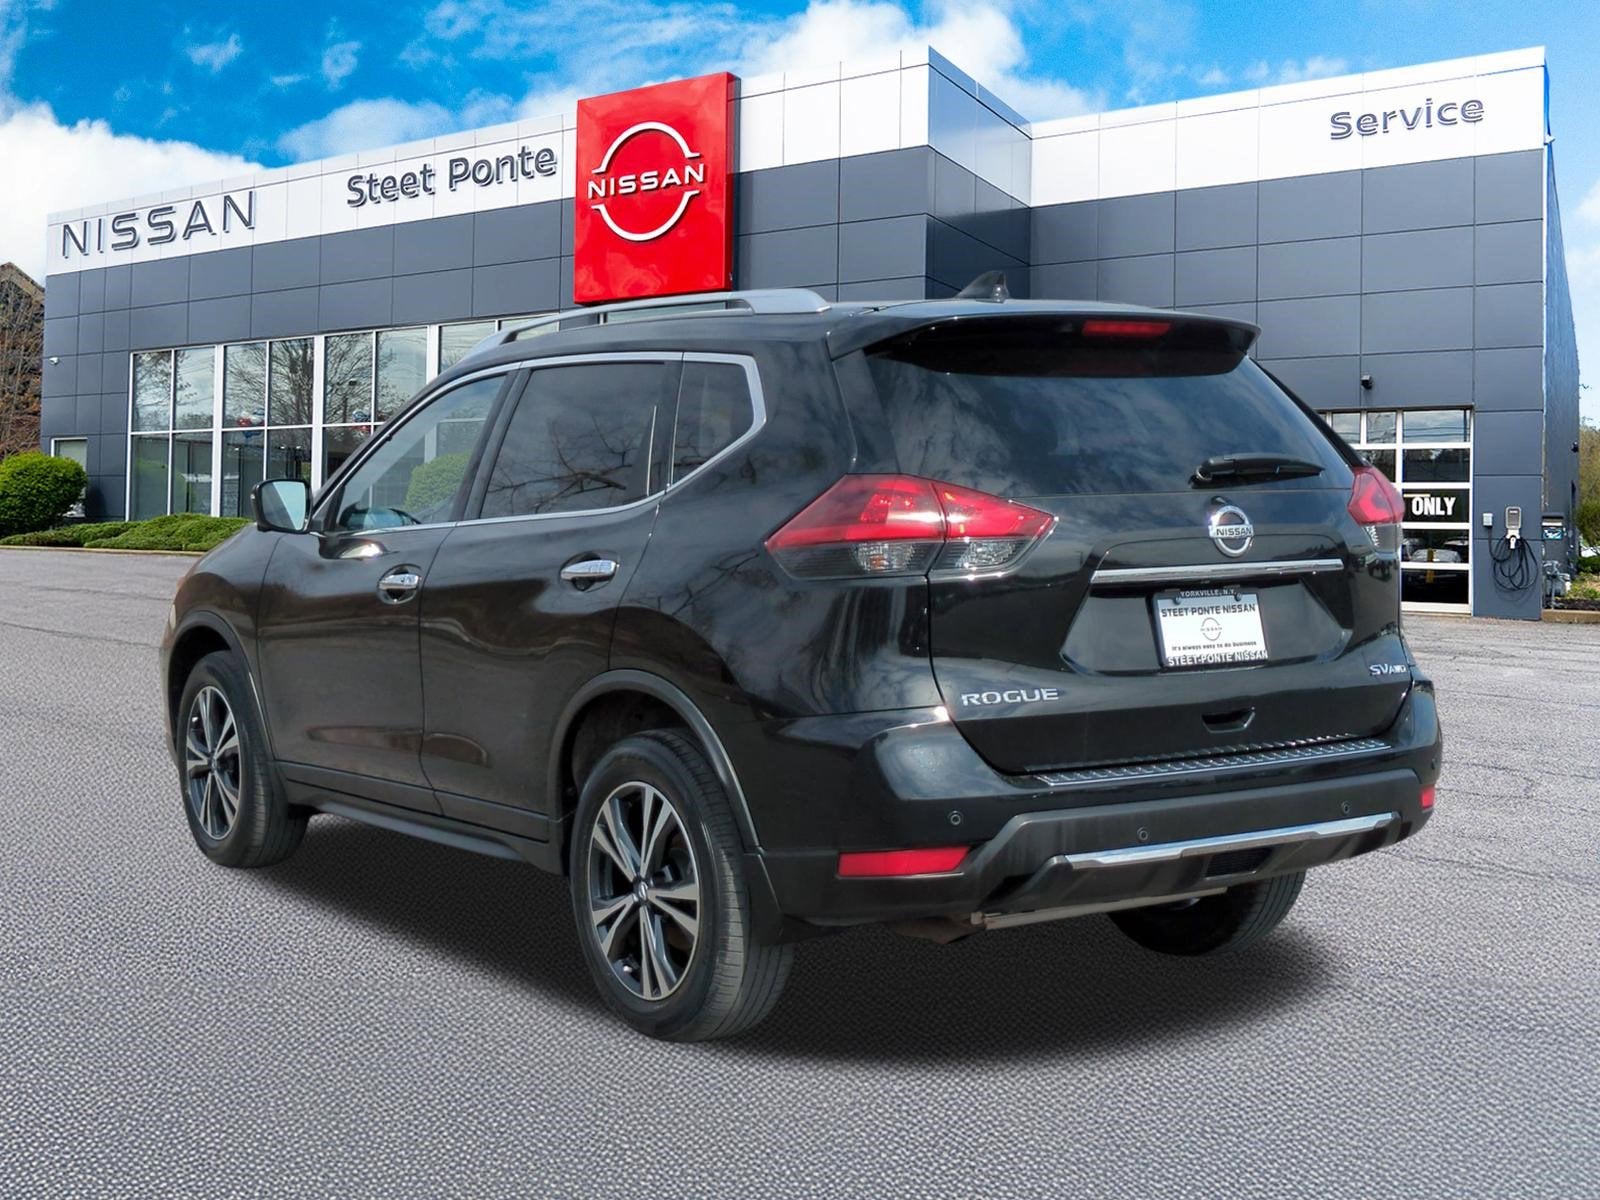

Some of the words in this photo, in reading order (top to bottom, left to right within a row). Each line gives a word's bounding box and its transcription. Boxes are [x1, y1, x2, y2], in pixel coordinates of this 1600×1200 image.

[1330, 97, 1485, 140] Service
[346, 162, 437, 208] Steet
[448, 145, 558, 192] Ponte
[587, 162, 705, 200] NISSAN
[62, 190, 256, 260] NISSAN
[1411, 496, 1456, 516] ONLY
[1216, 527, 1252, 536] NISSAN
[1222, 603, 1256, 614] NISSAN
[1234, 650, 1268, 661] NISSAN
[961, 688, 1059, 706] ROGUE
